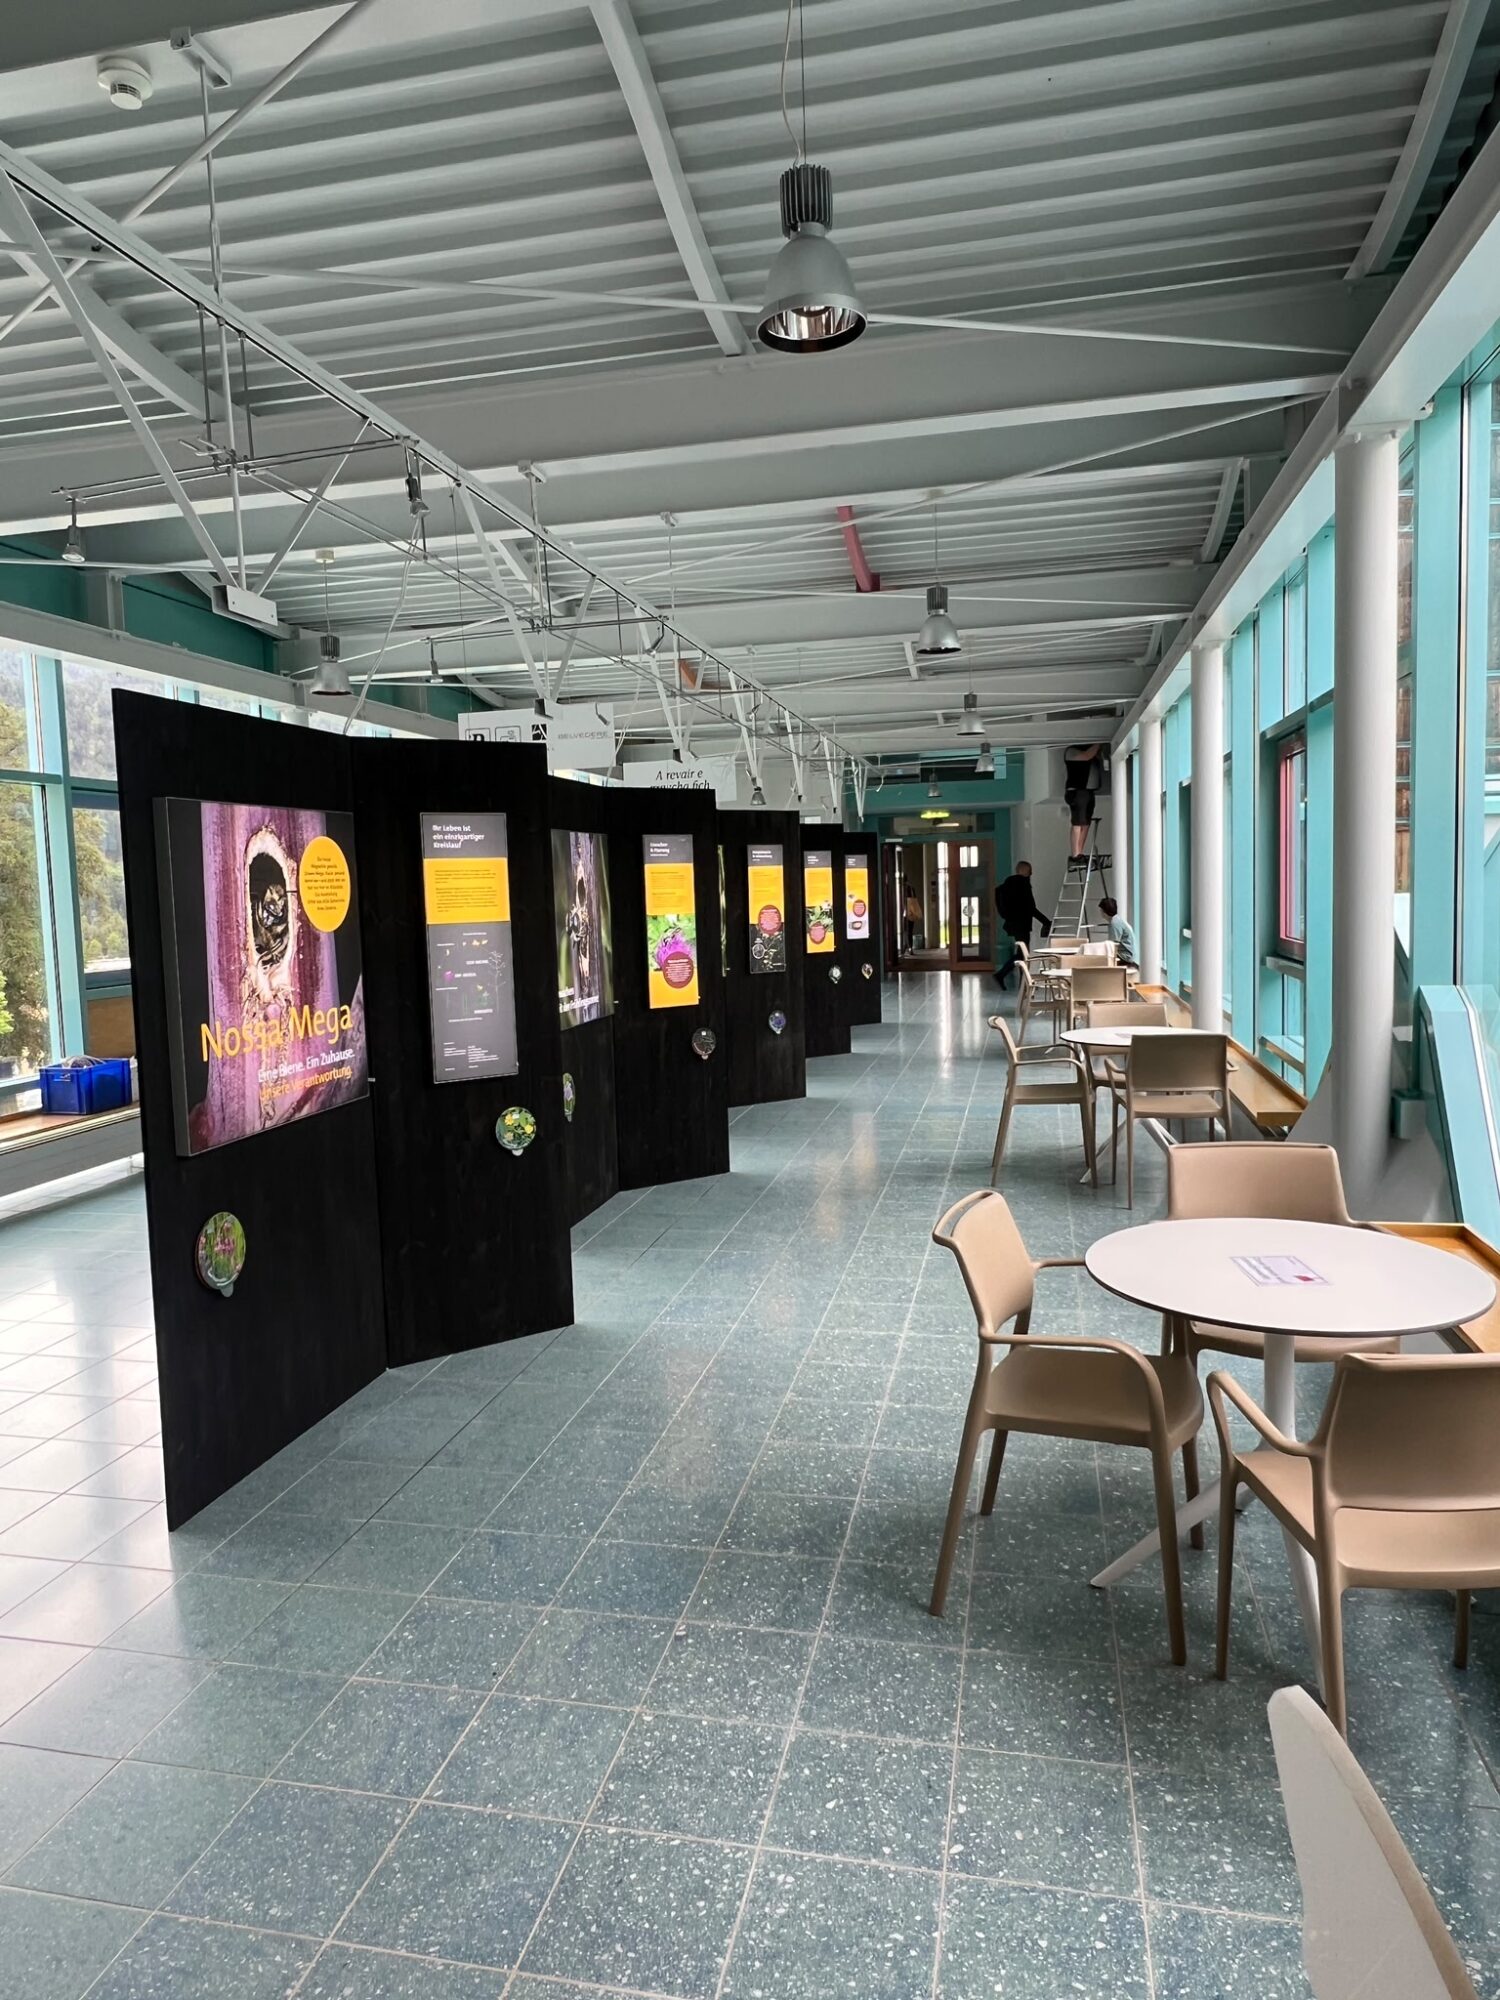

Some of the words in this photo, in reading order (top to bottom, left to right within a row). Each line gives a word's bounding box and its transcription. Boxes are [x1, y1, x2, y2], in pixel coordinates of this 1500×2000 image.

[656, 770, 663, 781] A
[666, 769, 695, 781] revair
[697, 769, 703, 779] e
[443, 824, 461, 832] Leben
[444, 833, 485, 842] einzigartiger
[200, 1017, 283, 1062] Nossa
[289, 1004, 353, 1044] Mega
[258, 1068, 279, 1083] Eine
[306, 1056, 319, 1069] Ein
[321, 1048, 355, 1065] Zuhause.
